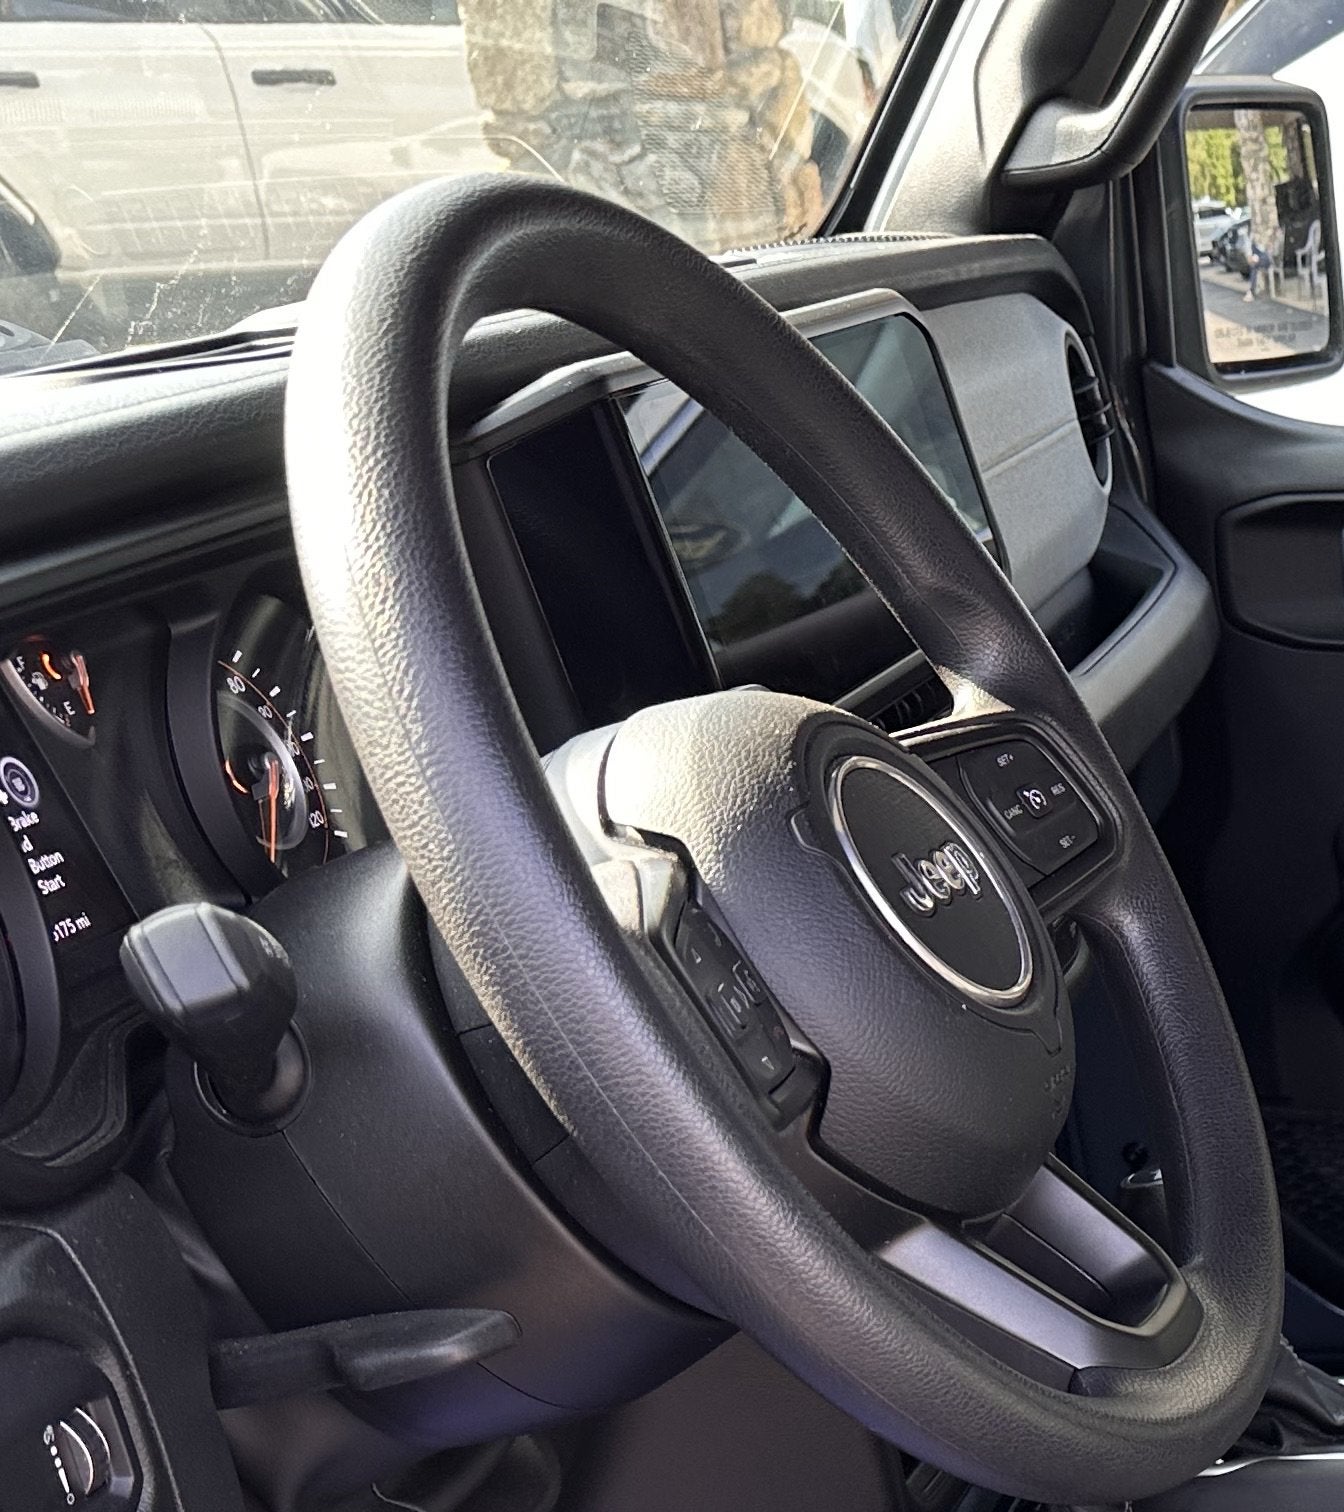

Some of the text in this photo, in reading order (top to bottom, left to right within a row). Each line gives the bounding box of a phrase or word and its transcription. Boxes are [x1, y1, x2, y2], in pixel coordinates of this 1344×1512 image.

[226, 675, 246, 694] 80
[63, 701, 76, 715] E
[27, 851, 65, 875] Button
[37, 873, 66, 895] Start
[891, 842, 981, 912] Jeep
[75, 911, 92, 930] mi
